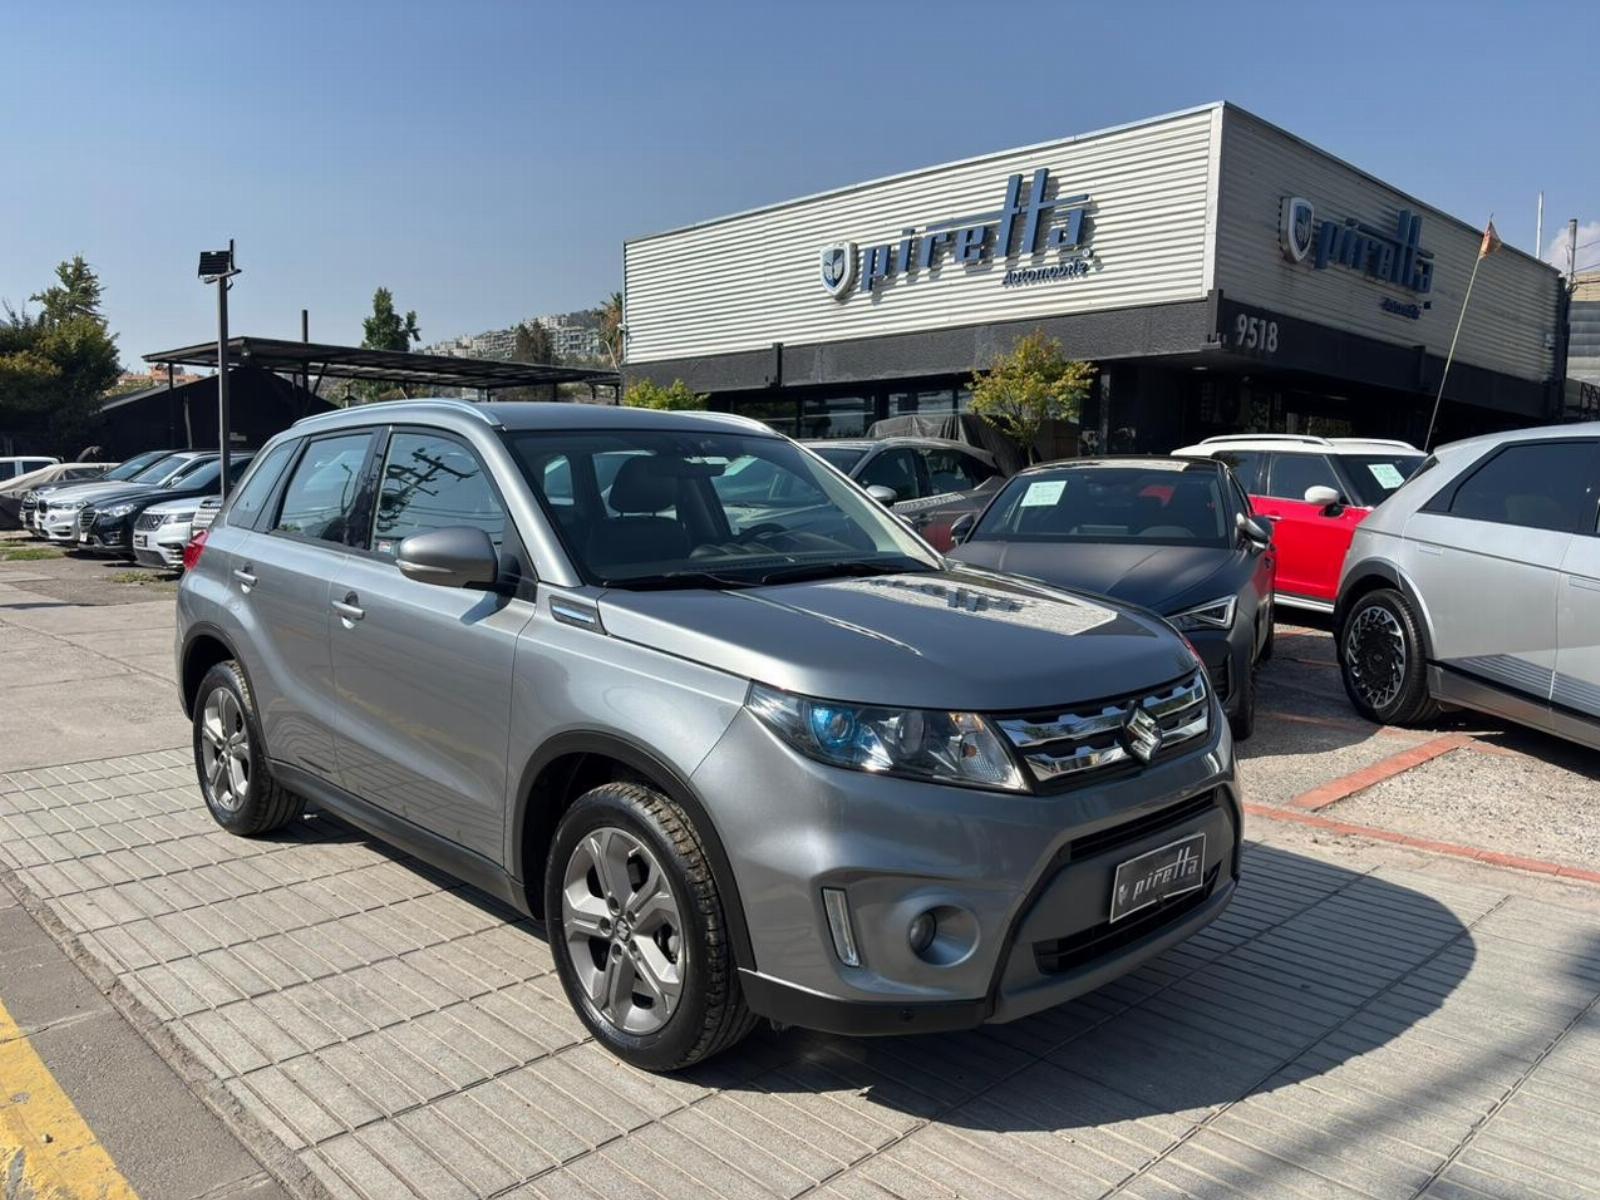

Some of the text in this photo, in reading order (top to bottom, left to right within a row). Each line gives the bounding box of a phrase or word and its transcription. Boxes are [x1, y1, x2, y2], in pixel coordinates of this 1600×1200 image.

[860, 167, 1090, 293] piretta
[1236, 313, 1279, 353] 9518
[1132, 846, 1200, 901] piretta
